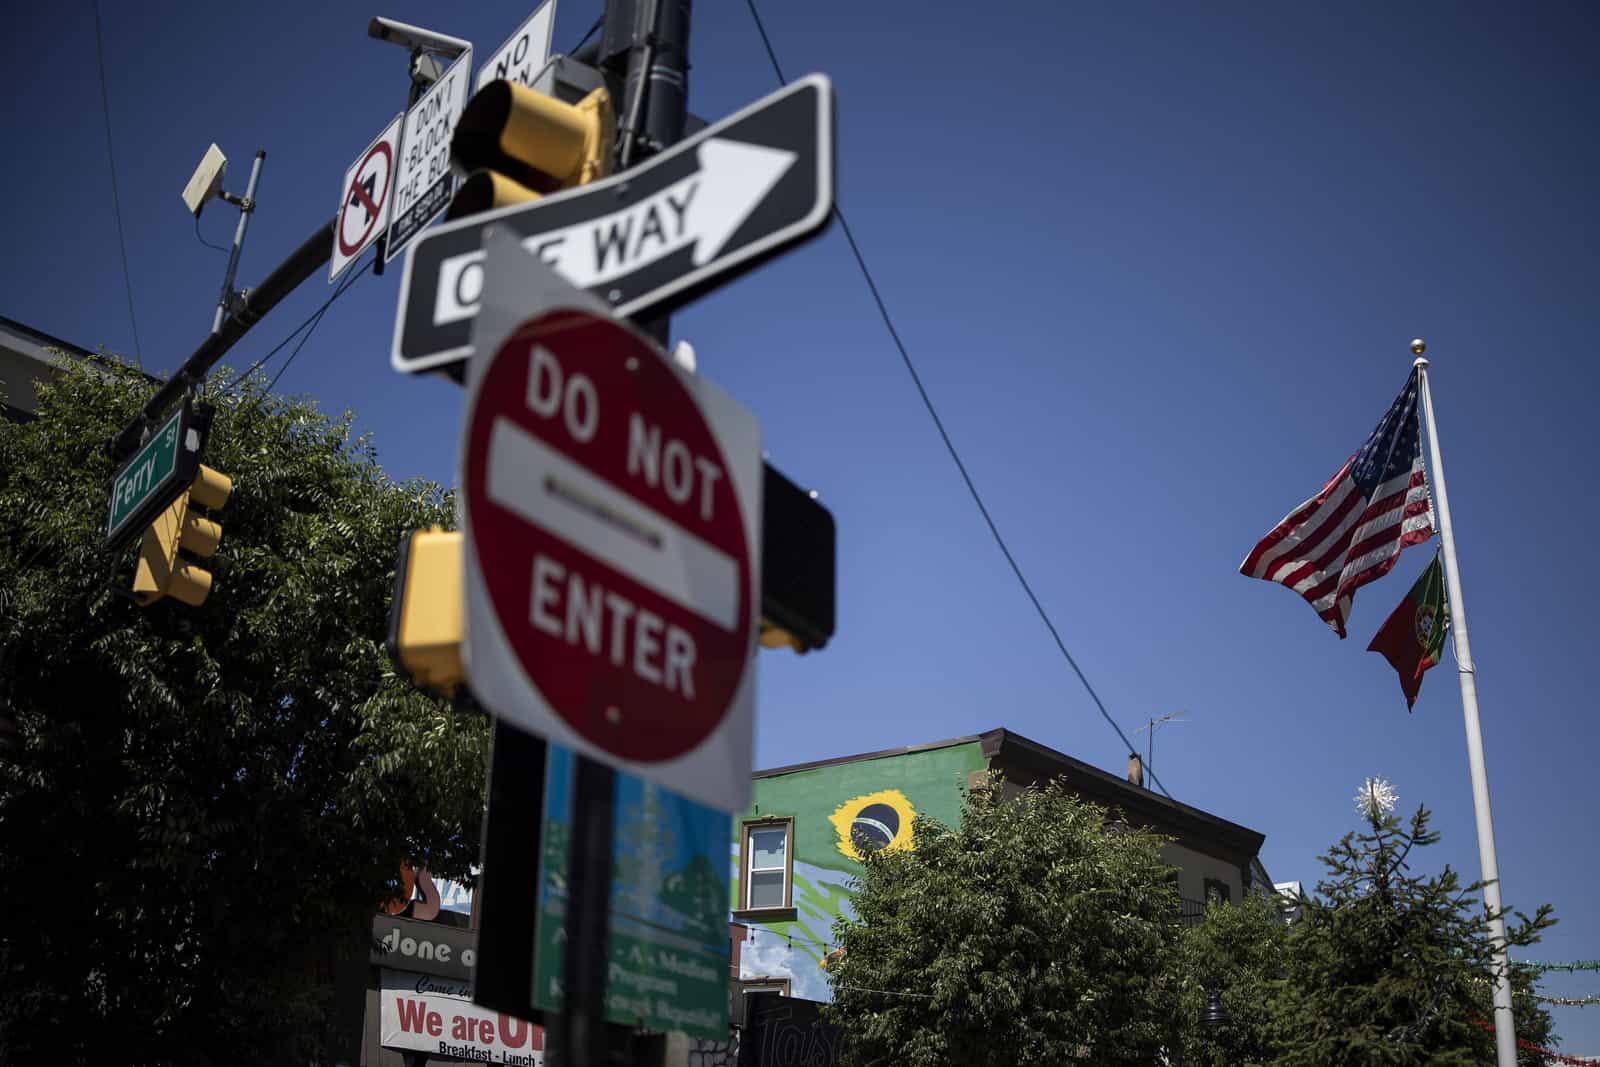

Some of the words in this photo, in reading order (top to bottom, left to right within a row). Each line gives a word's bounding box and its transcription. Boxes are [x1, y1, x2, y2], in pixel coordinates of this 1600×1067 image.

[494, 33, 530, 81] NO
[409, 108, 452, 171] BLOCK
[428, 145, 449, 186] BO
[398, 169, 422, 217] THE
[593, 180, 699, 273] WAY
[525, 342, 600, 444] DO
[627, 410, 723, 522] NOT
[114, 451, 158, 517] Ferry
[528, 552, 697, 700] ENTER
[396, 998, 443, 1037] We
[451, 1015, 495, 1045] are
[438, 1040, 492, 1063] Breakfast
[502, 1050, 536, 1067] Lunch
